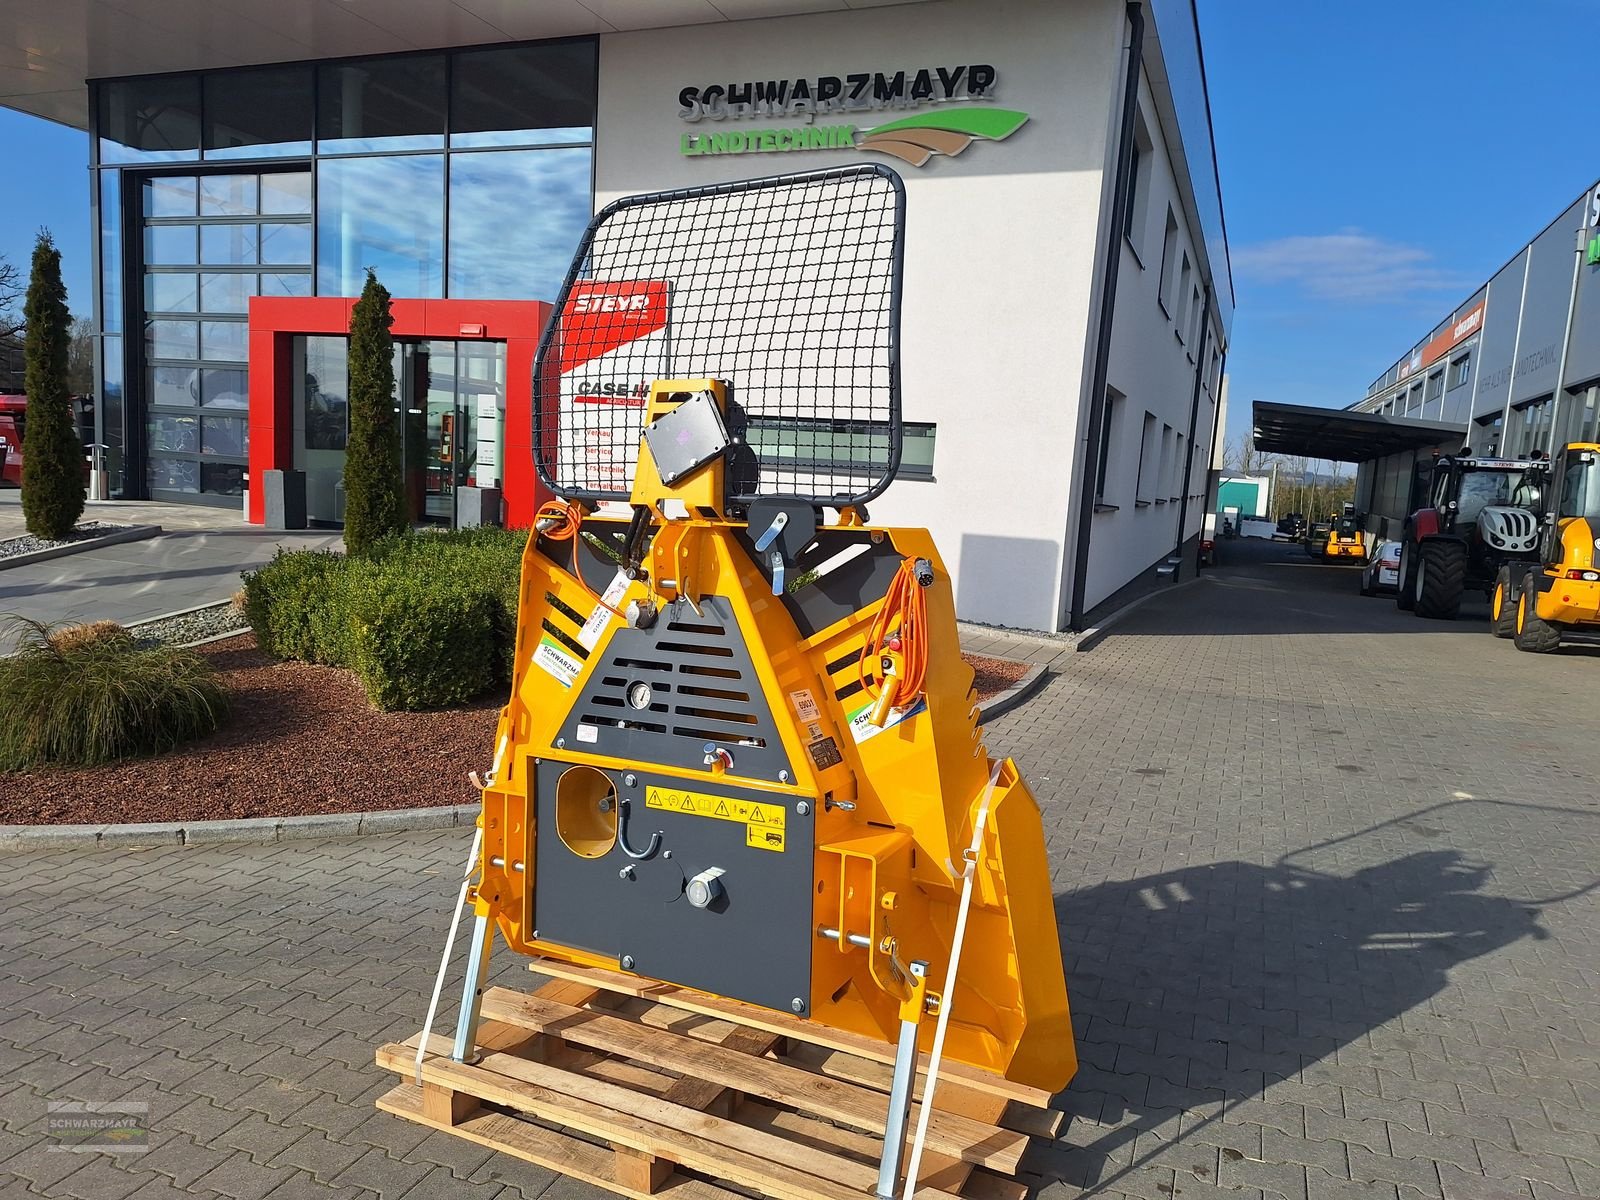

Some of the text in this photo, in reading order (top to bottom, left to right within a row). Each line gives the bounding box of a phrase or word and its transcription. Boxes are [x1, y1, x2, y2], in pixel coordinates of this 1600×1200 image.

[678, 64, 996, 109] SCHWARZMAYR
[680, 124, 856, 156] LANDTECHNIK
[574, 293, 649, 312] STEYR
[578, 382, 629, 396] CASE
[587, 429, 613, 437] Verkau
